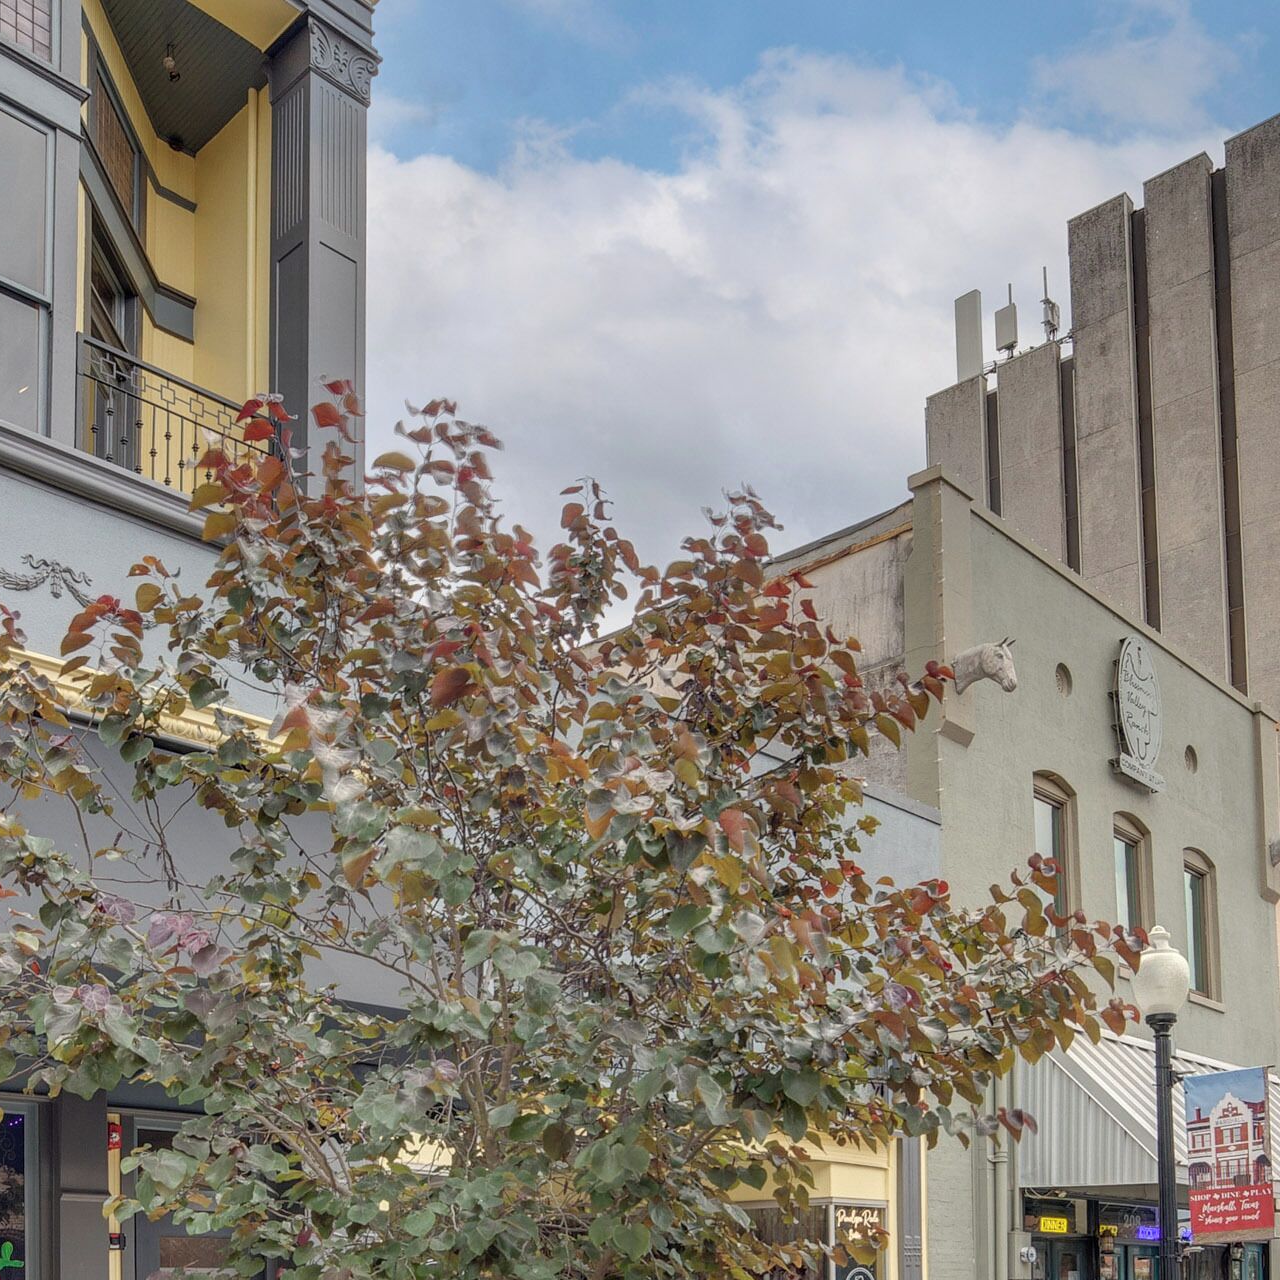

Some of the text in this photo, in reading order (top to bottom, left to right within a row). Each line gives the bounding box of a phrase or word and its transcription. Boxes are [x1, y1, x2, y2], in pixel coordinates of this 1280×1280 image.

[1190, 1188, 1272, 1202] SHOP DINE PLAY
[1239, 1198, 1260, 1211] Texas
